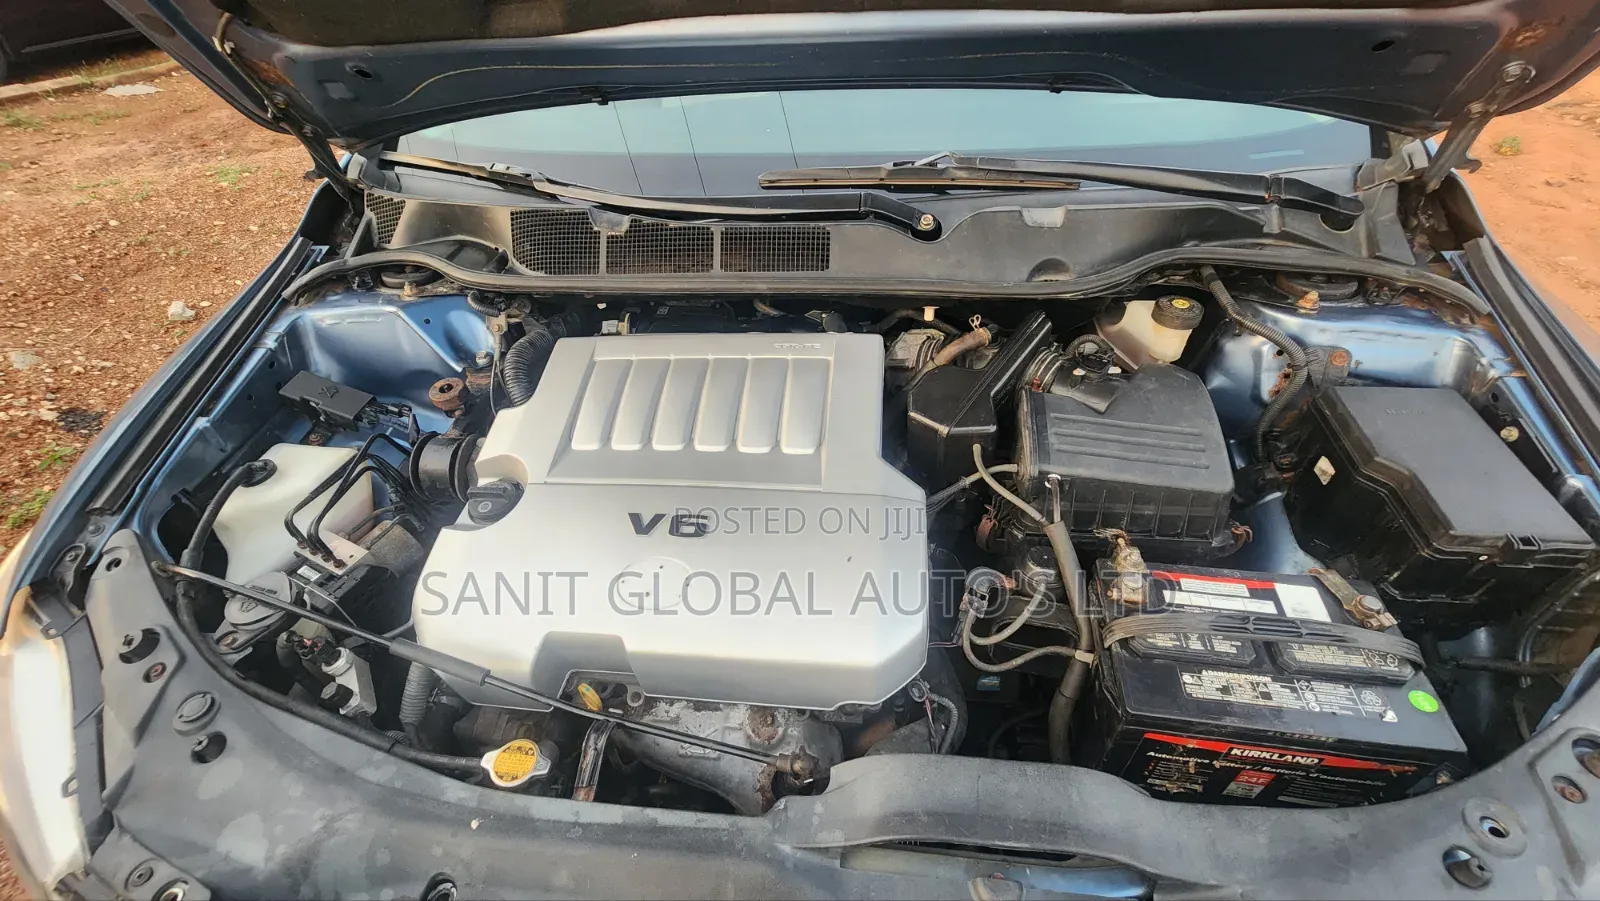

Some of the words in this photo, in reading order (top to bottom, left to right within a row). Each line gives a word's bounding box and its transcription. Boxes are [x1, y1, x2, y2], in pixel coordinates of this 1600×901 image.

[627, 512, 710, 538] V6
[1146, 751, 1211, 764] Automotive
[1230, 748, 1320, 765] KIRKLAND
